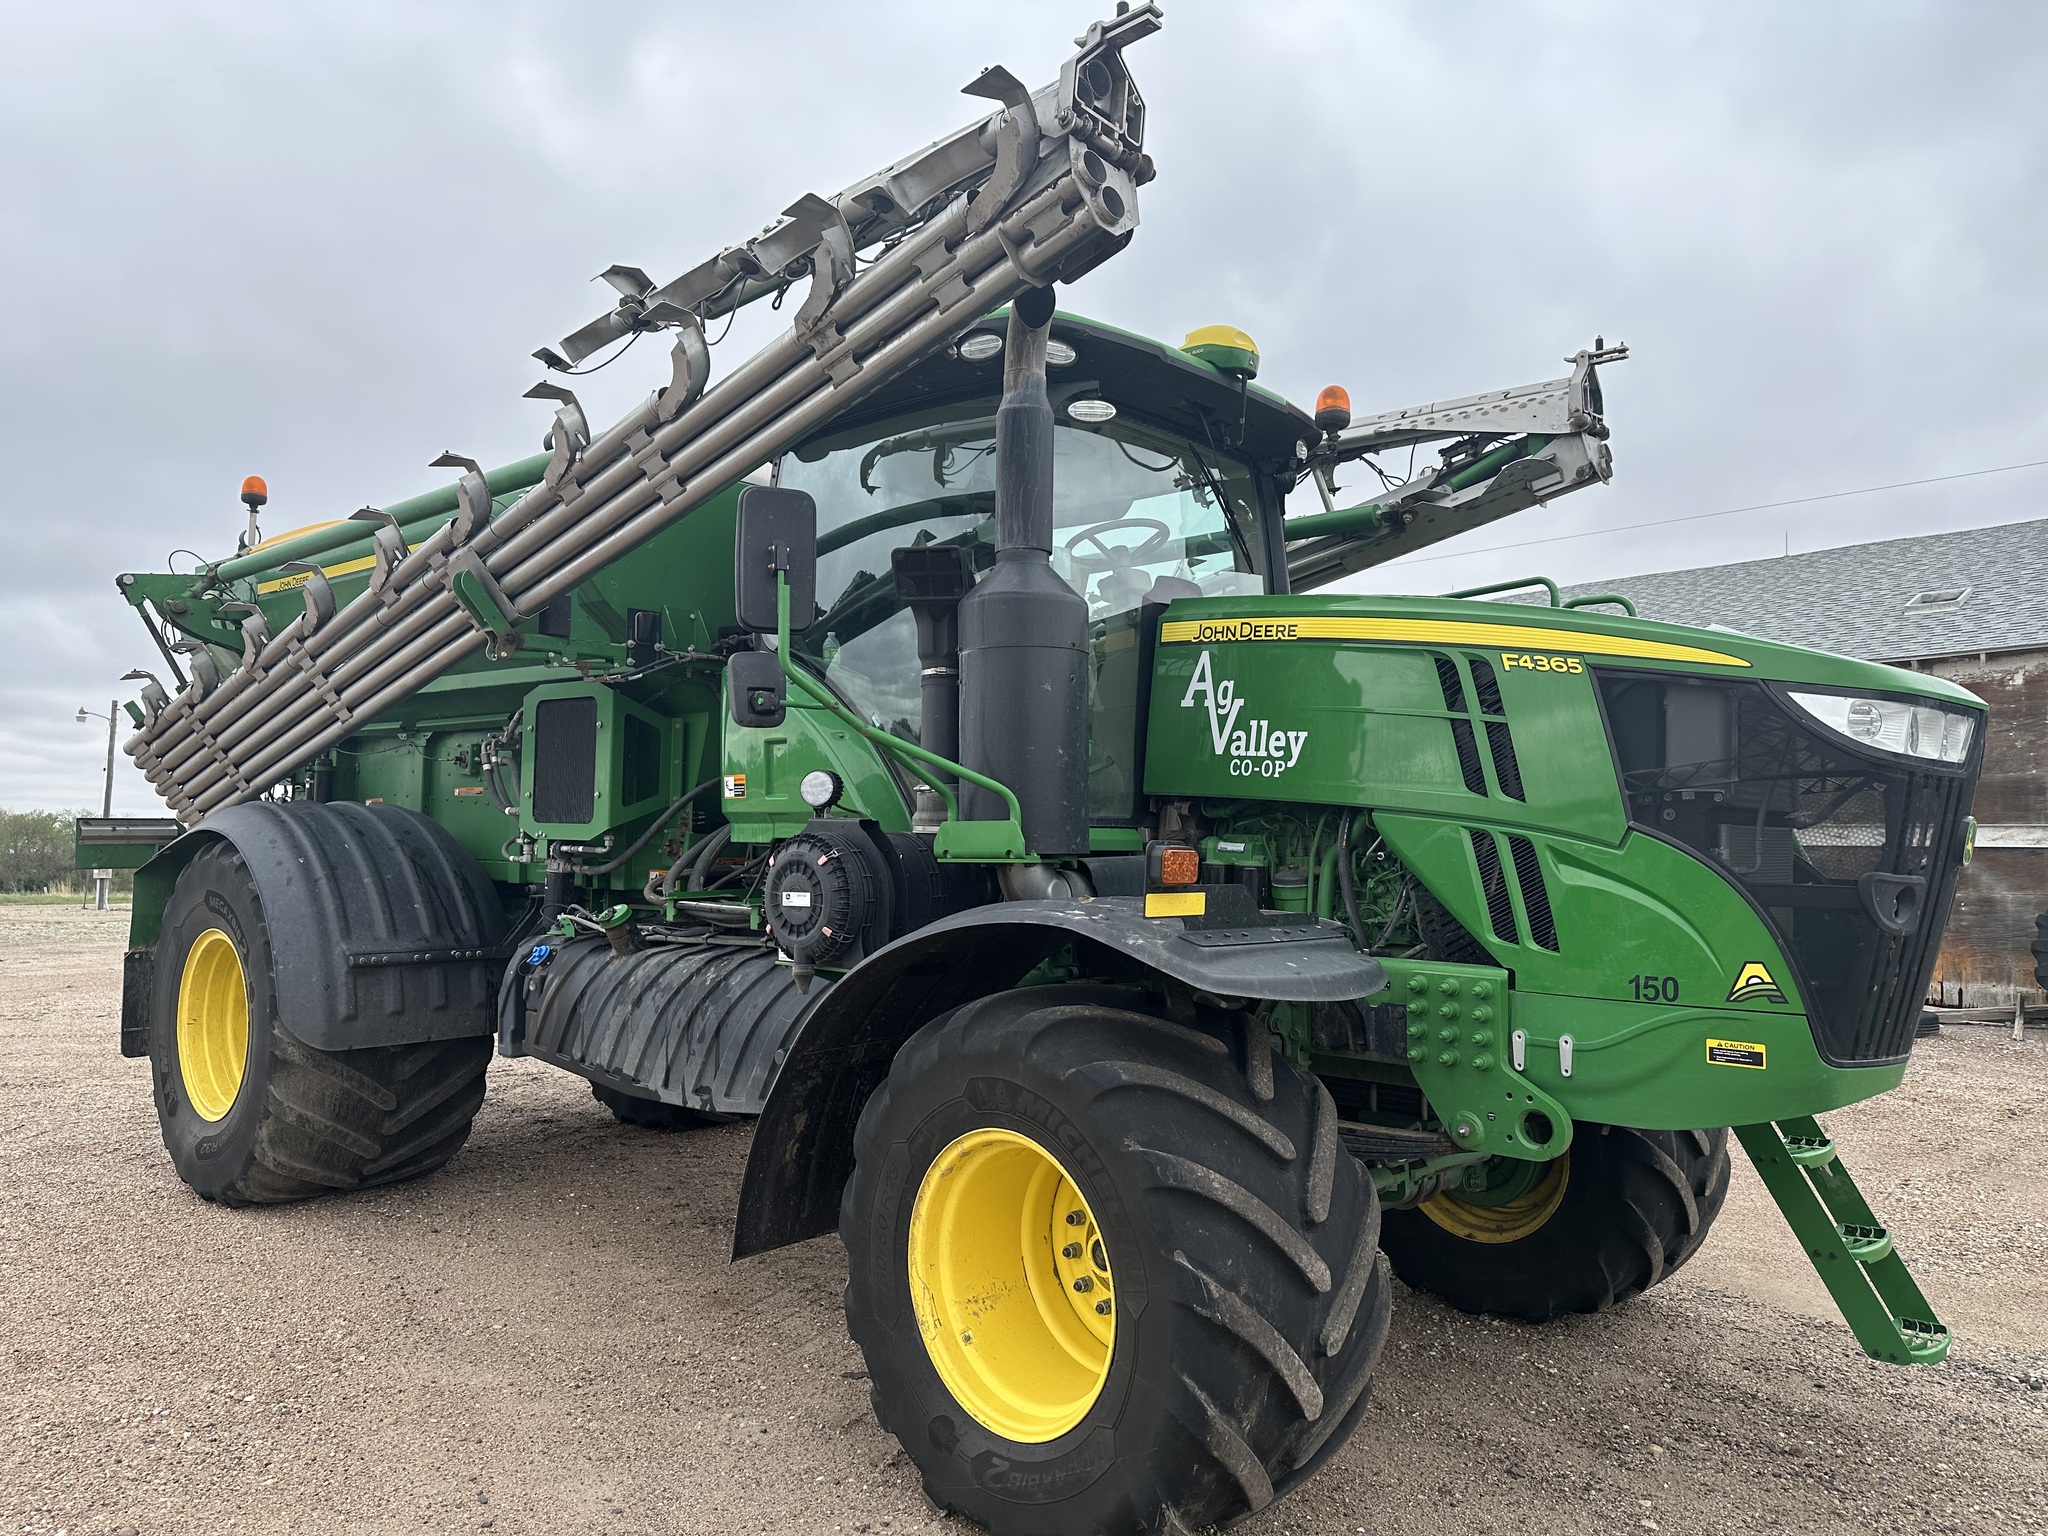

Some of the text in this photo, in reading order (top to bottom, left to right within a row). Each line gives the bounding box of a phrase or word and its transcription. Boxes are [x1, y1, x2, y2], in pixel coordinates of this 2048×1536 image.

[278, 580, 291, 589] JOHN
[1193, 622, 1298, 640] JOHN DEERE
[1500, 653, 1583, 674] F4365
[1180, 650, 1235, 715] Ag
[1204, 698, 1308, 768] Valley
[1229, 759, 1286, 777] CO-OP
[1628, 974, 1680, 1002] 150
[1724, 1042, 1755, 1051] CAUTION
